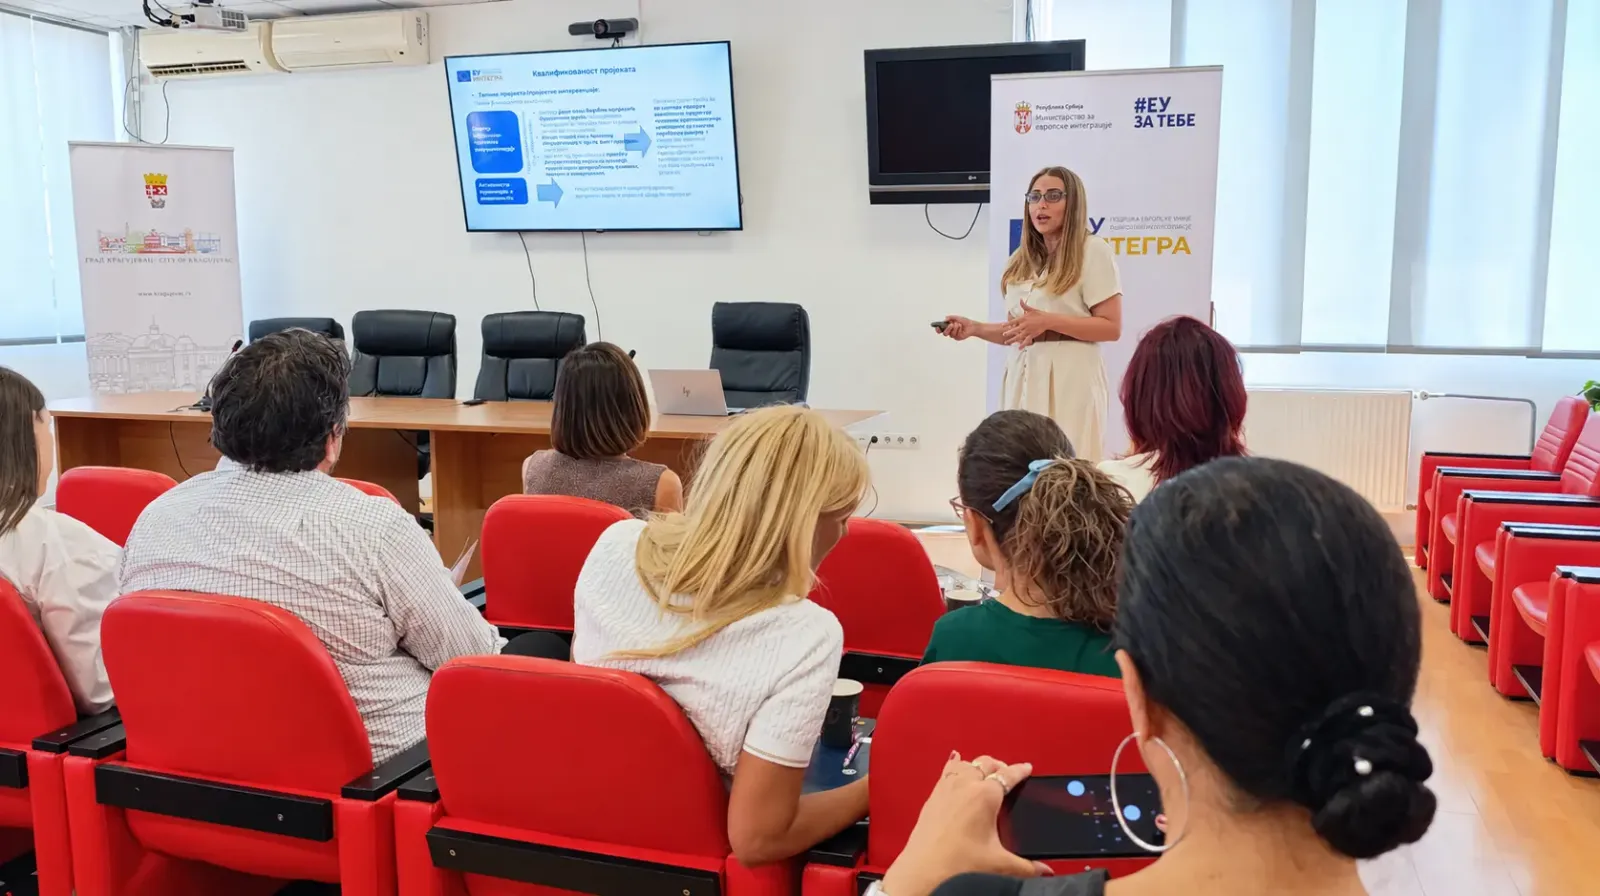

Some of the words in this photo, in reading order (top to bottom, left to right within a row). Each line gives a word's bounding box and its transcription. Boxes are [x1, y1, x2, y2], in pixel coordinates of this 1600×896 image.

[532, 68, 598, 77] Квалификованост
[600, 66, 636, 75] пројеката
[1036, 104, 1064, 112] Република
[1134, 96, 1171, 114] #ЕУ
[1070, 122, 1112, 130] интеграције
[1134, 116, 1154, 128] ЗА
[1156, 114, 1196, 127] ТЕБЕ
[1089, 217, 1105, 235] У
[1103, 236, 1191, 255] ТЕГРА
